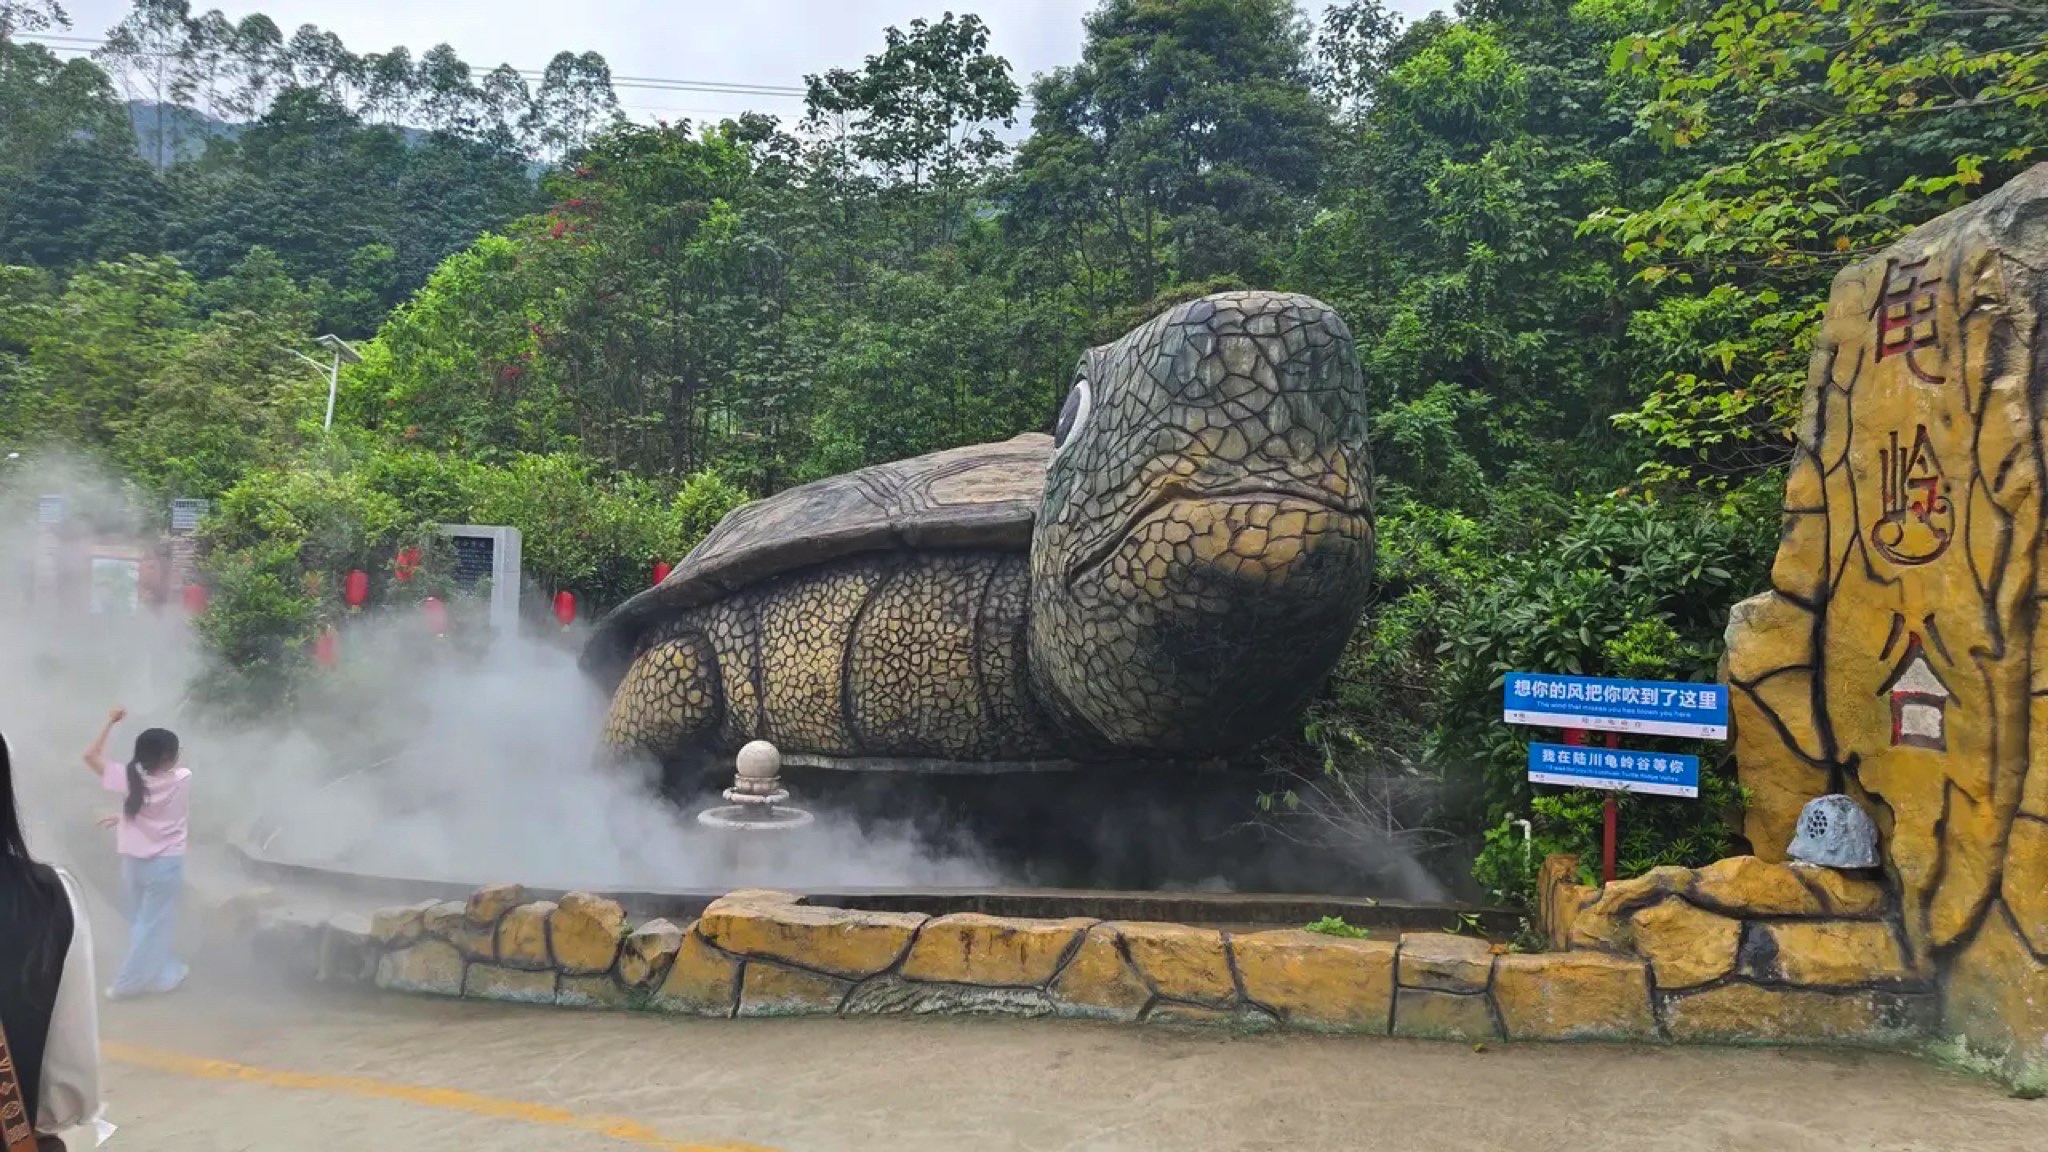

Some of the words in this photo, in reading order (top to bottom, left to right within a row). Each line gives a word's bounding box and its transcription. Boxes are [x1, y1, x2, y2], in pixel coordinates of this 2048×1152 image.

[1513, 679, 1717, 710] 想你的风把你吹到了这里
